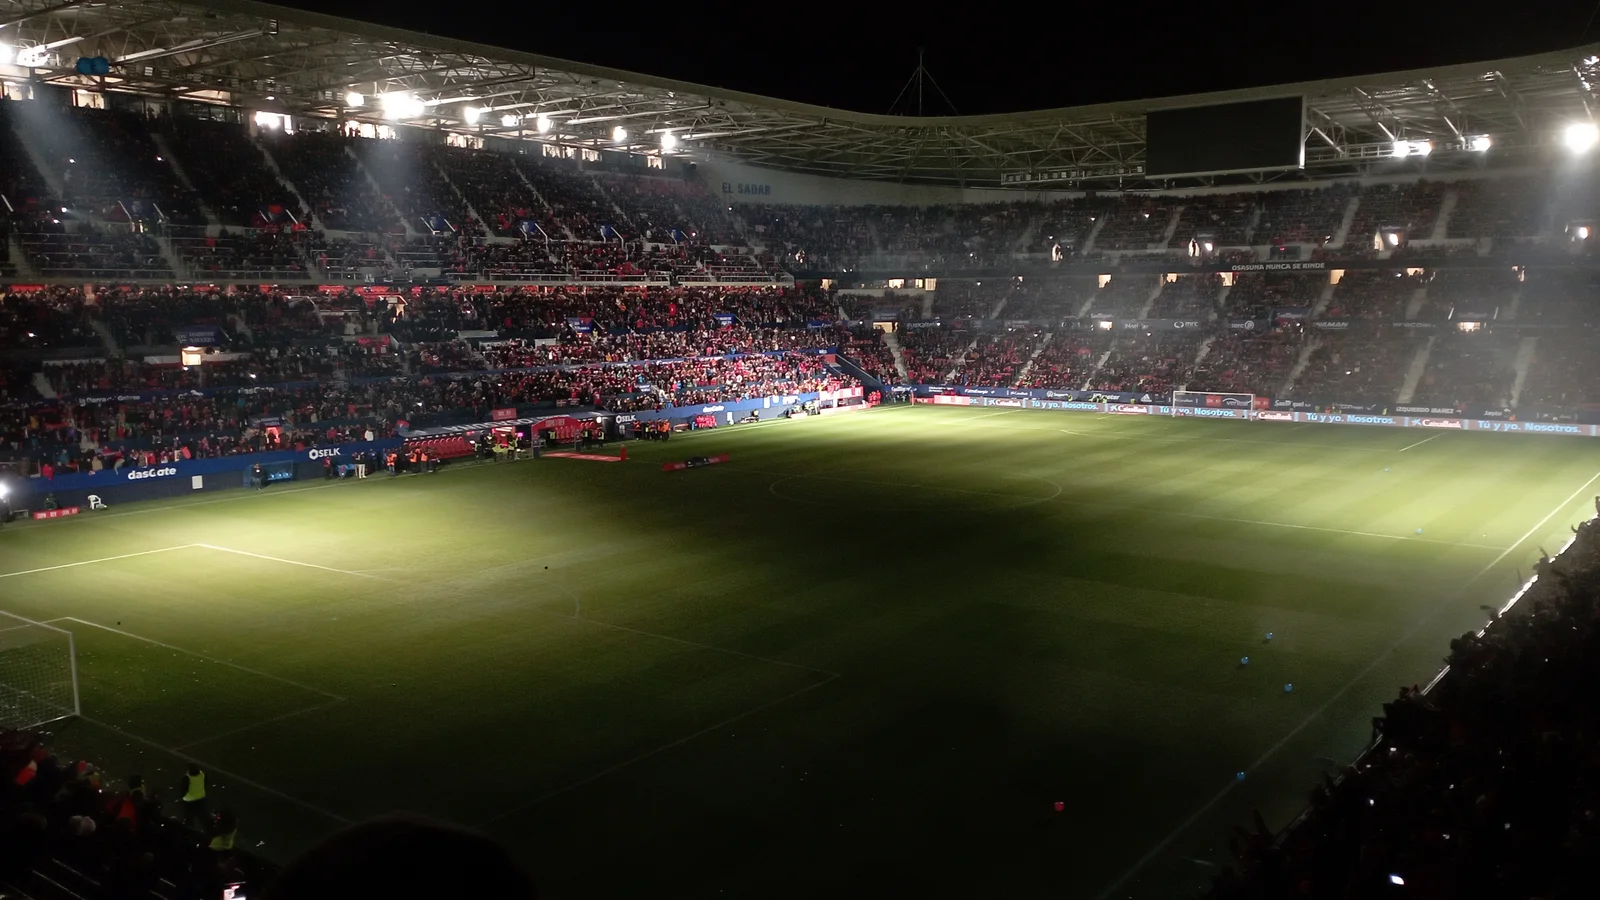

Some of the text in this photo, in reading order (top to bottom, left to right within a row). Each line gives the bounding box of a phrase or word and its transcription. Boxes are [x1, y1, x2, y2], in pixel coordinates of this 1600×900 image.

[722, 182, 771, 195] EL SADAR
[1062, 401, 1099, 410] Nosotros.
[1194, 408, 1236, 417] Nosotros.
[1306, 412, 1317, 420] Tú
[1347, 414, 1396, 424] Nosotros.
[1478, 420, 1490, 428] Tú
[1493, 422, 1500, 431] y
[1525, 422, 1581, 433] Nosotros.
[318, 447, 341, 457] SELK
[128, 467, 177, 480] dasGate
